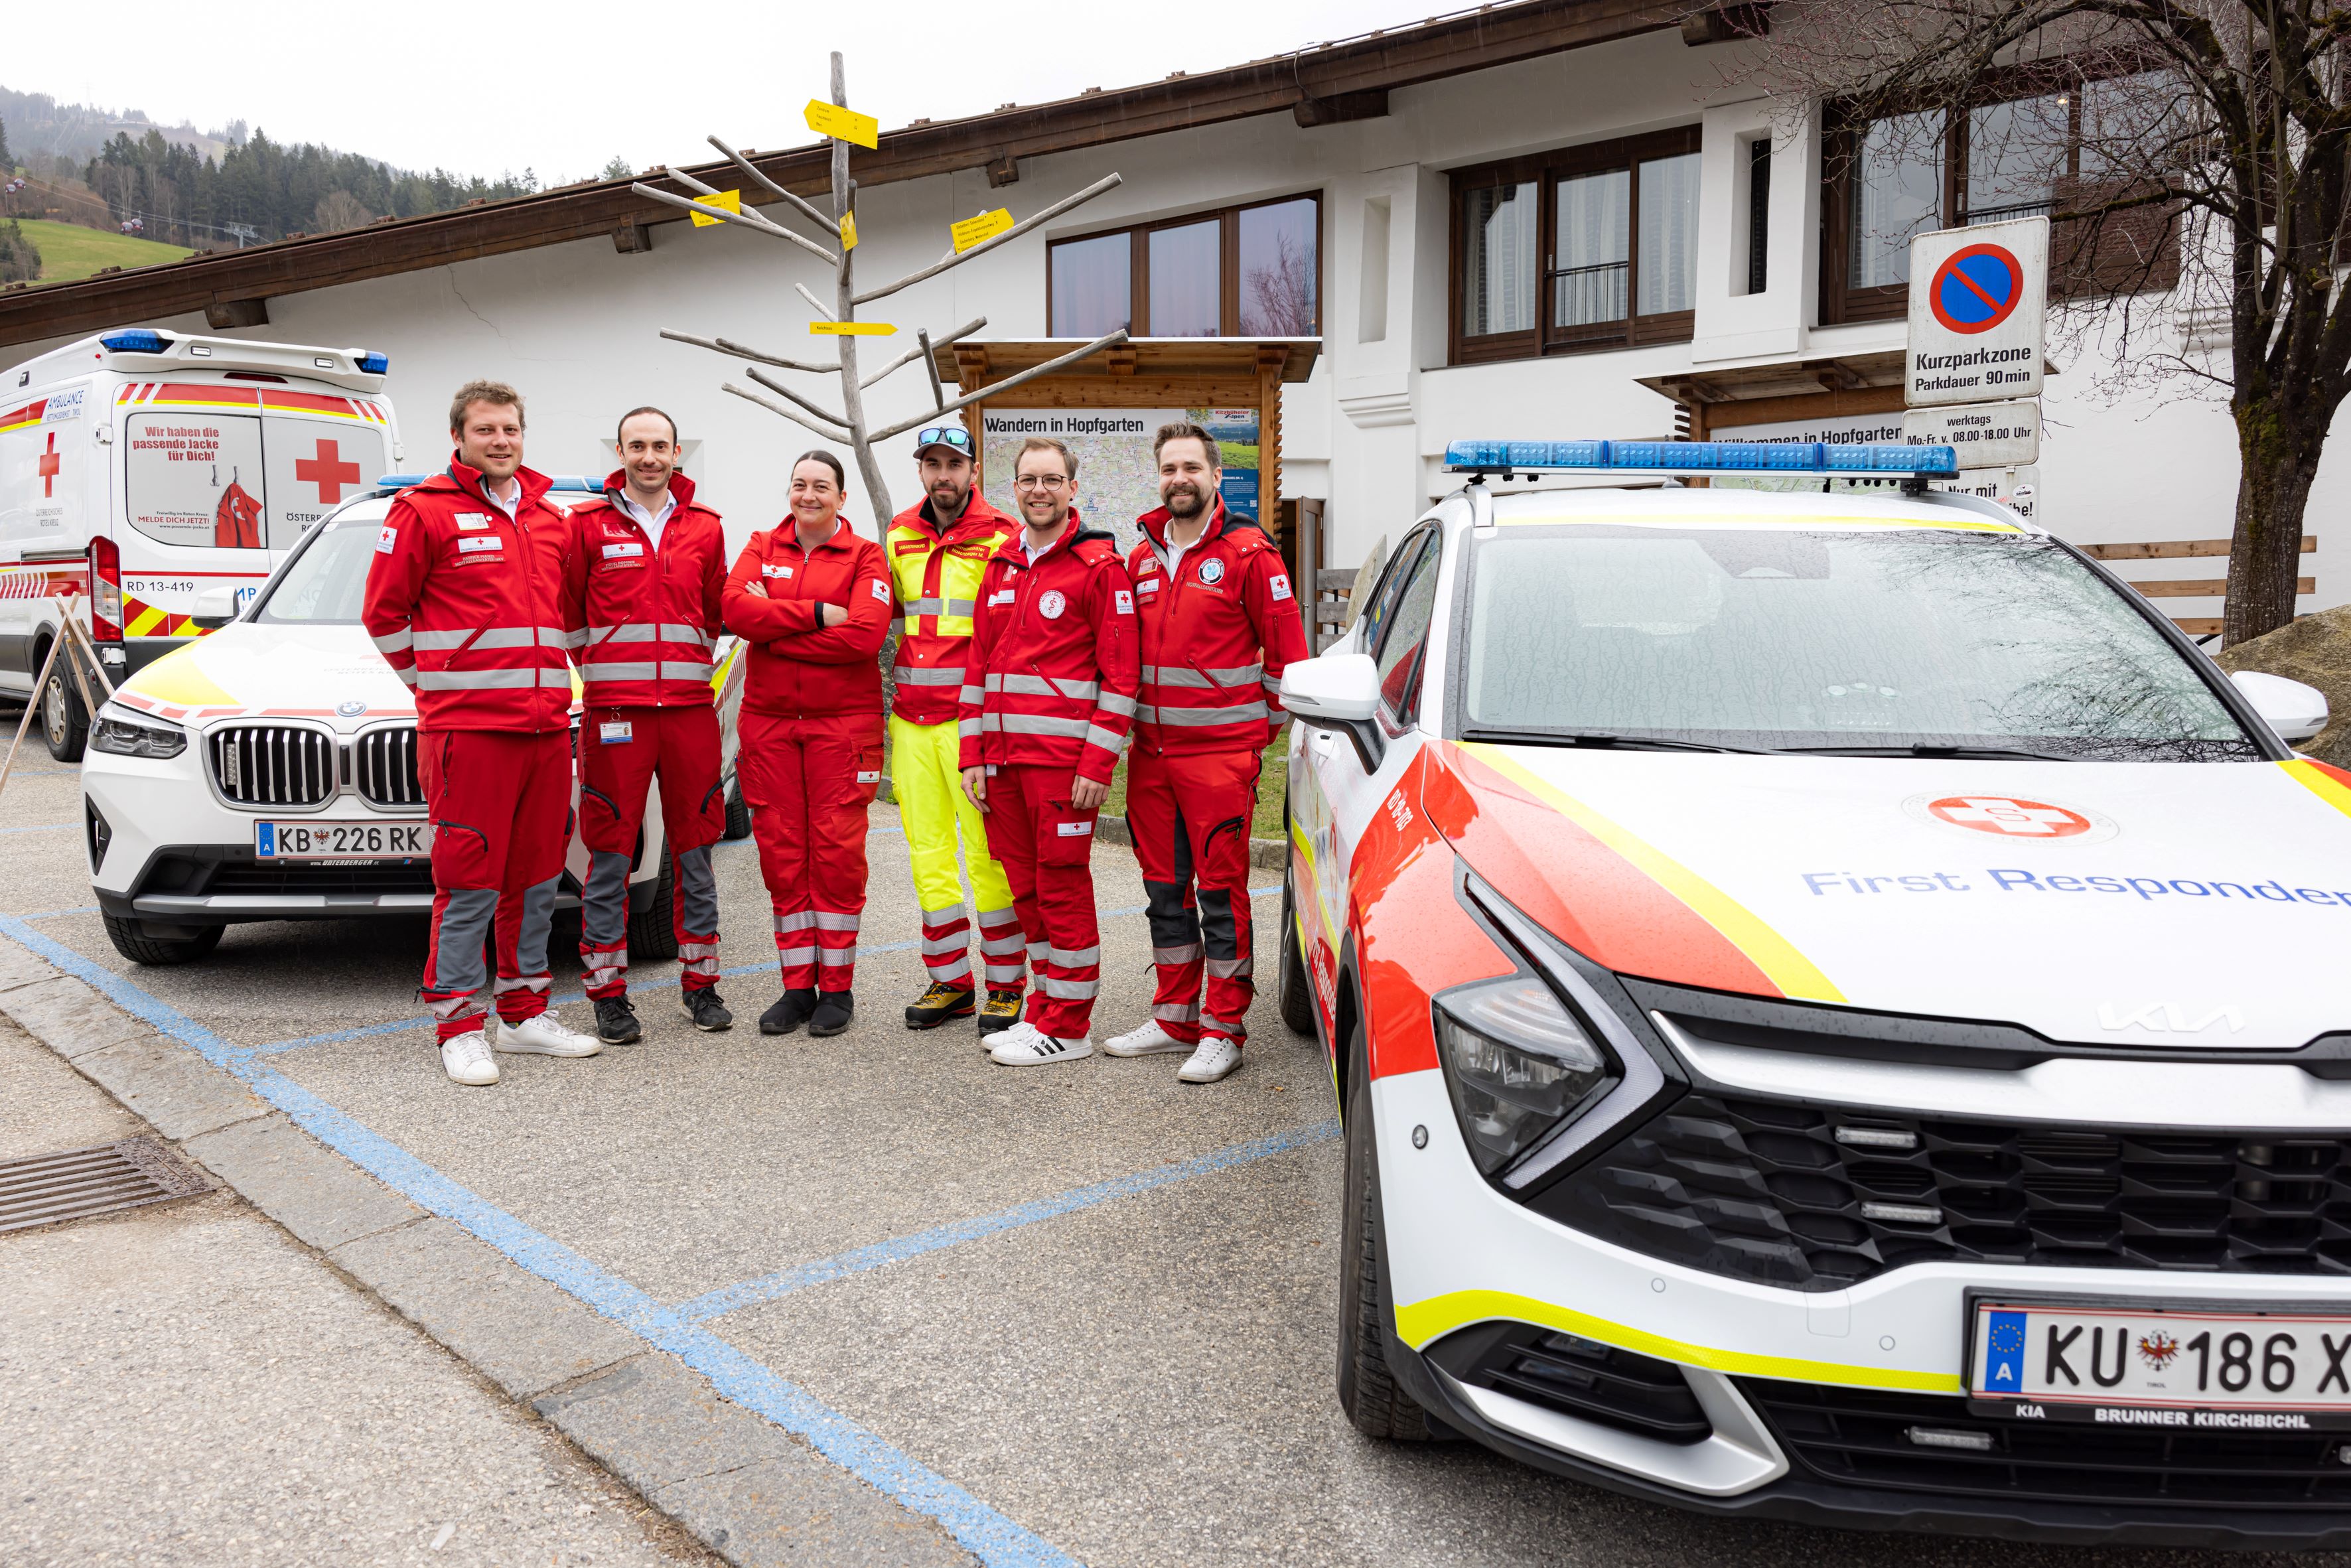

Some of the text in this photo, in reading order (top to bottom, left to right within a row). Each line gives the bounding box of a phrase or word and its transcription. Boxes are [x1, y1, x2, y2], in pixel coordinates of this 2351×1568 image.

[1916, 347, 2031, 371] Kurzparkzone
[1915, 369, 2030, 391] Parkdauer 90 min
[48, 390, 84, 409] AMBULANCE
[985, 418, 1144, 434] Wandern in Hopfgarten
[1947, 415, 1991, 427] werktags
[145, 427, 220, 437] Wir haben die
[1804, 433, 1817, 443] in
[1821, 426, 1902, 444] Hopfgarten
[1907, 434, 1937, 445] Mo.-Fr.
[2014, 427, 2032, 438] Uhr
[133, 439, 219, 450] passende Jacke
[168, 451, 215, 461] für Dich!
[1976, 483, 1997, 497] mit
[286, 512, 324, 522] ÖSTERR
[127, 581, 194, 591] RD 13-419
[1387, 788, 1413, 831] RD 18-703
[279, 827, 311, 852] KB
[332, 827, 382, 852] 226
[390, 827, 422, 851] RK
[1800, 869, 2351, 908] First Responder
[1317, 946, 1336, 1025] Responde
[1995, 1324, 2351, 1394] A KU 186 X
[2016, 1404, 2311, 1429] KIA BRUNNER KIRCHBICHL
